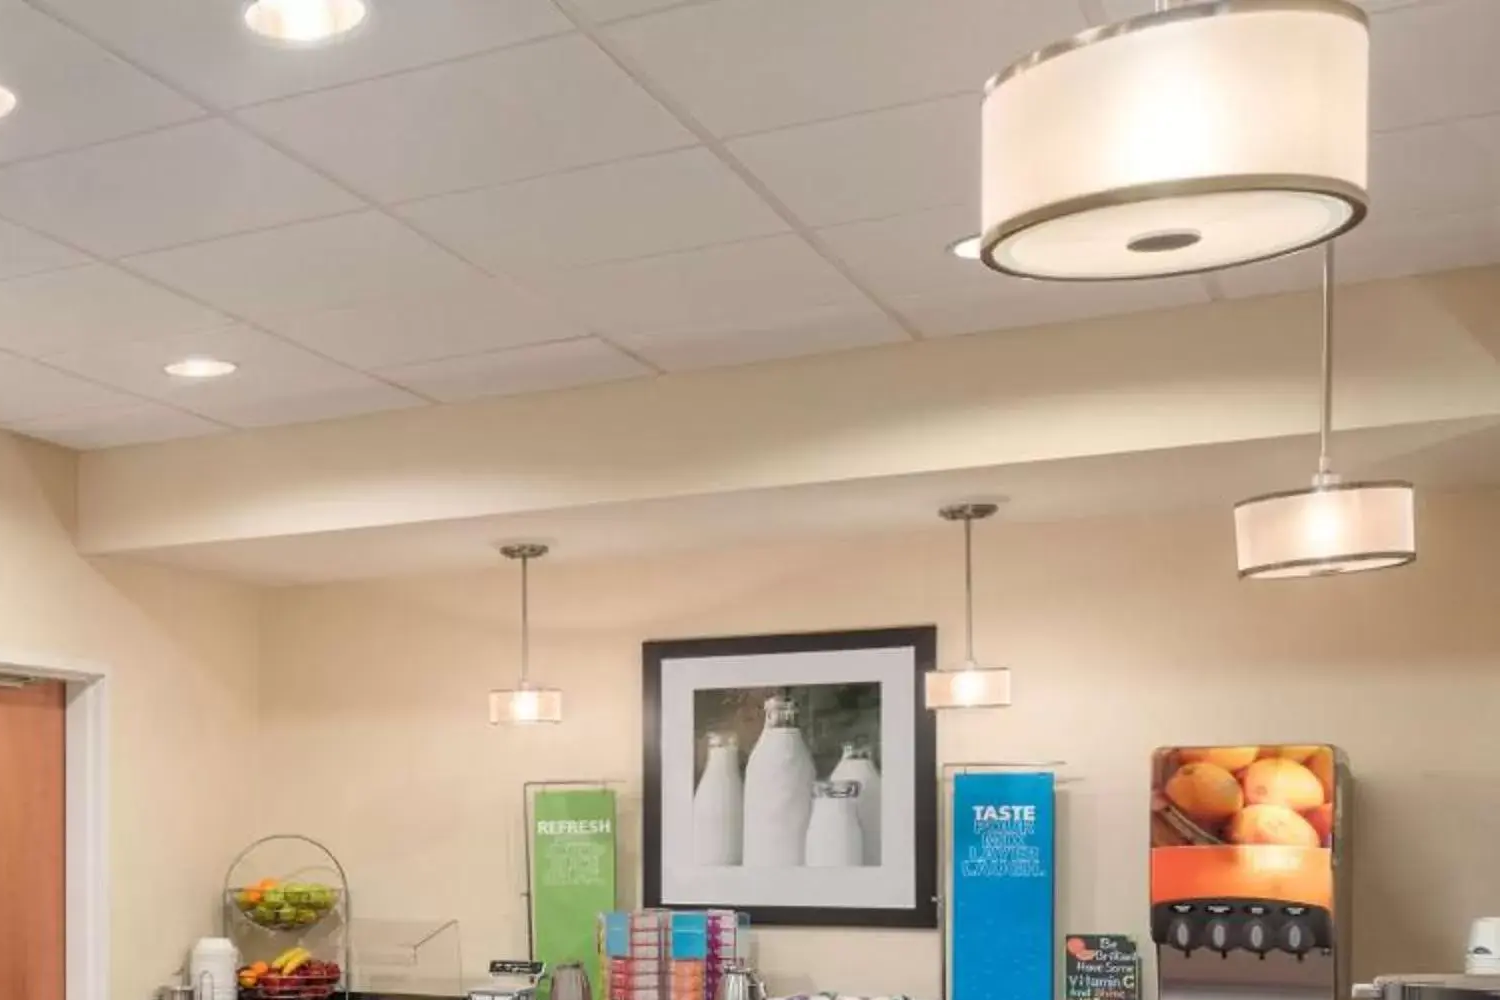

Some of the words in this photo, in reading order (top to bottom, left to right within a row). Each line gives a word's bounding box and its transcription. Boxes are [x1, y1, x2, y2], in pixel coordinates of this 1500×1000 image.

[972, 805, 1036, 820] TASTE
[537, 819, 612, 834] REFRESH
[1123, 975, 1135, 989] C
